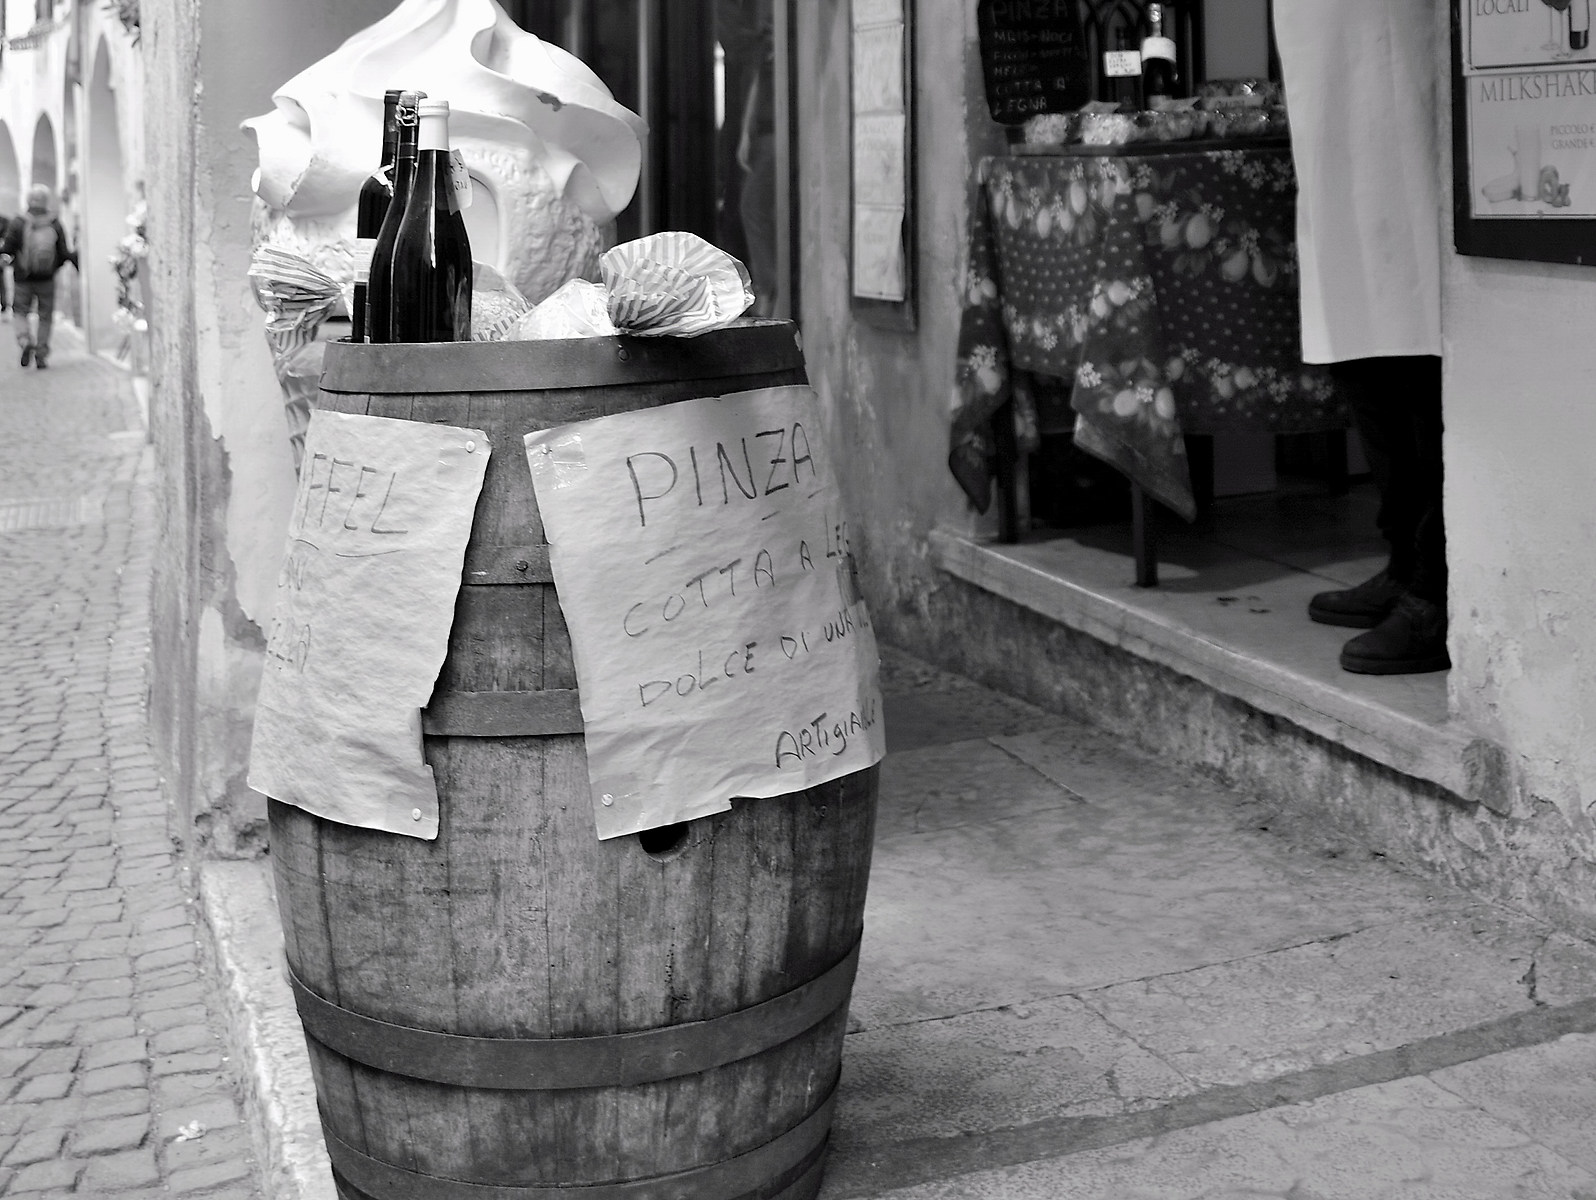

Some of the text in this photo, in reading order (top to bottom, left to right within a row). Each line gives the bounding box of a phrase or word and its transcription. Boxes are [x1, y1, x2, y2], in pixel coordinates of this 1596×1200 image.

[1481, 71, 1596, 103] MILKSHAK
[626, 422, 816, 527] PINZA
[622, 547, 775, 638] COTTA
[799, 540, 815, 571] A
[638, 641, 758, 708] DOLCE
[781, 631, 809, 660] DI
[823, 608, 857, 643] UNA
